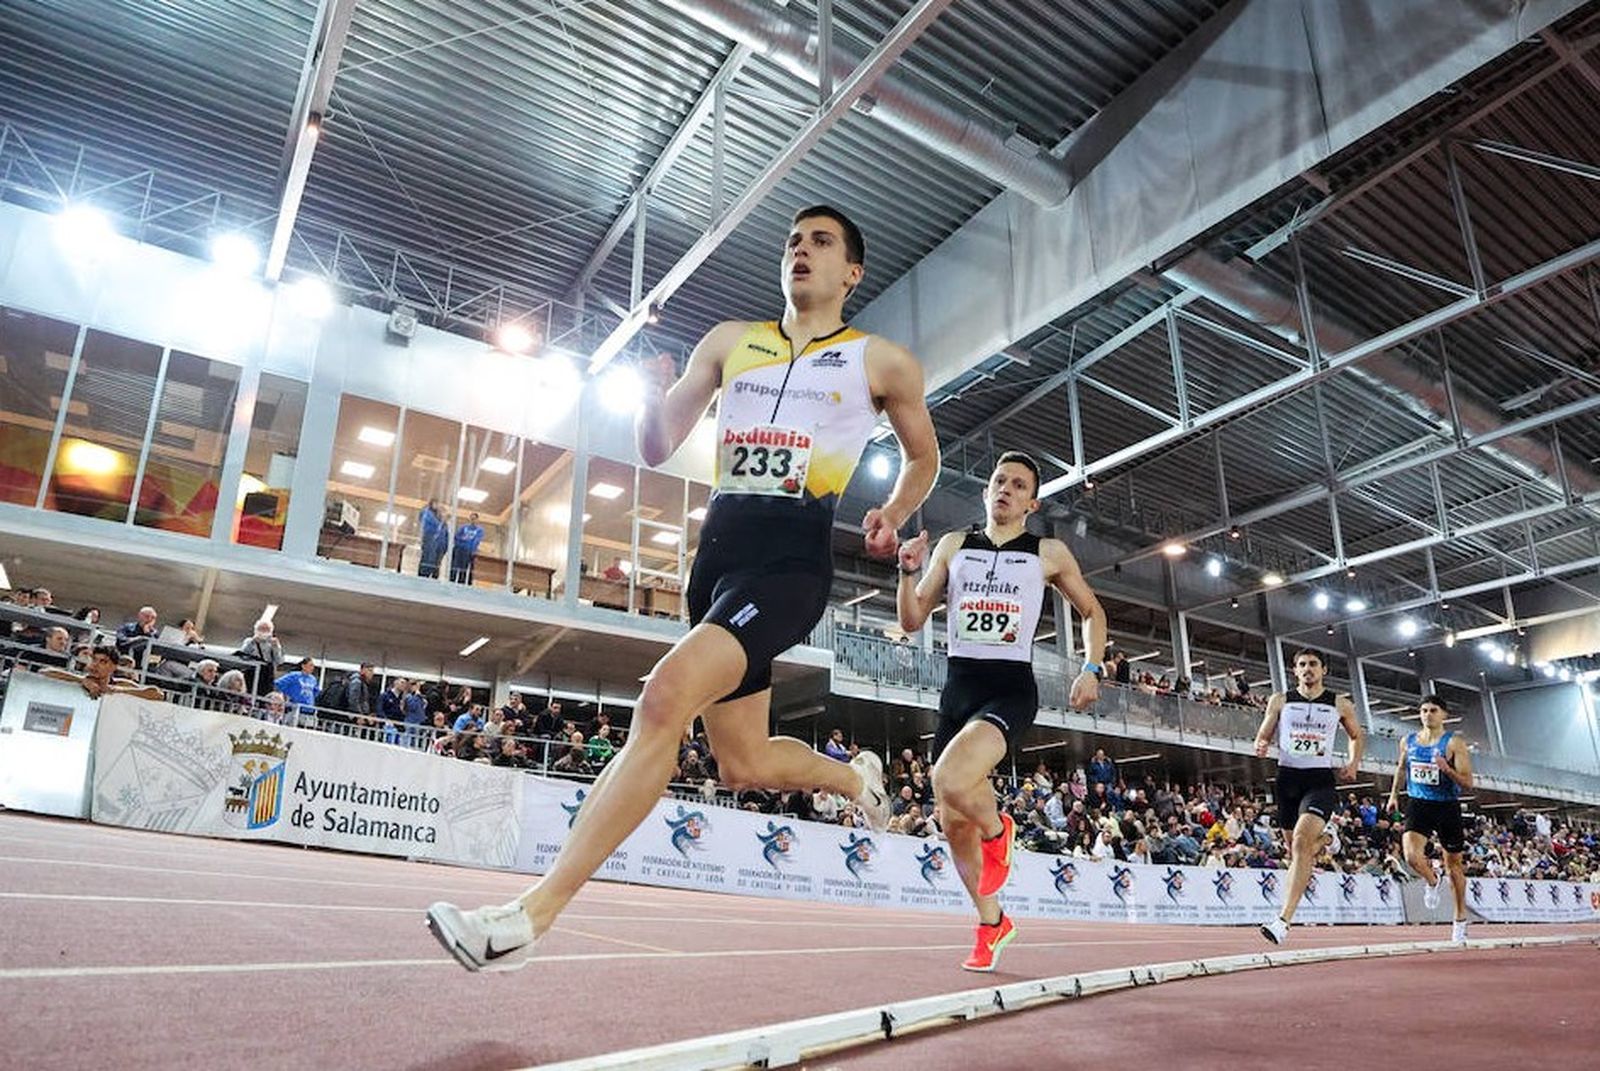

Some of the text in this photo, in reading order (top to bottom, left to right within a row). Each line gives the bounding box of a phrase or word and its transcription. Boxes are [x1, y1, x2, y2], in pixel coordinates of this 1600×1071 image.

[731, 446, 792, 478] 233
[966, 612, 1010, 633] 289
[1294, 739, 1320, 752] 291
[293, 771, 441, 815] Ayuntamiento
[290, 803, 437, 843] de Salamanca
